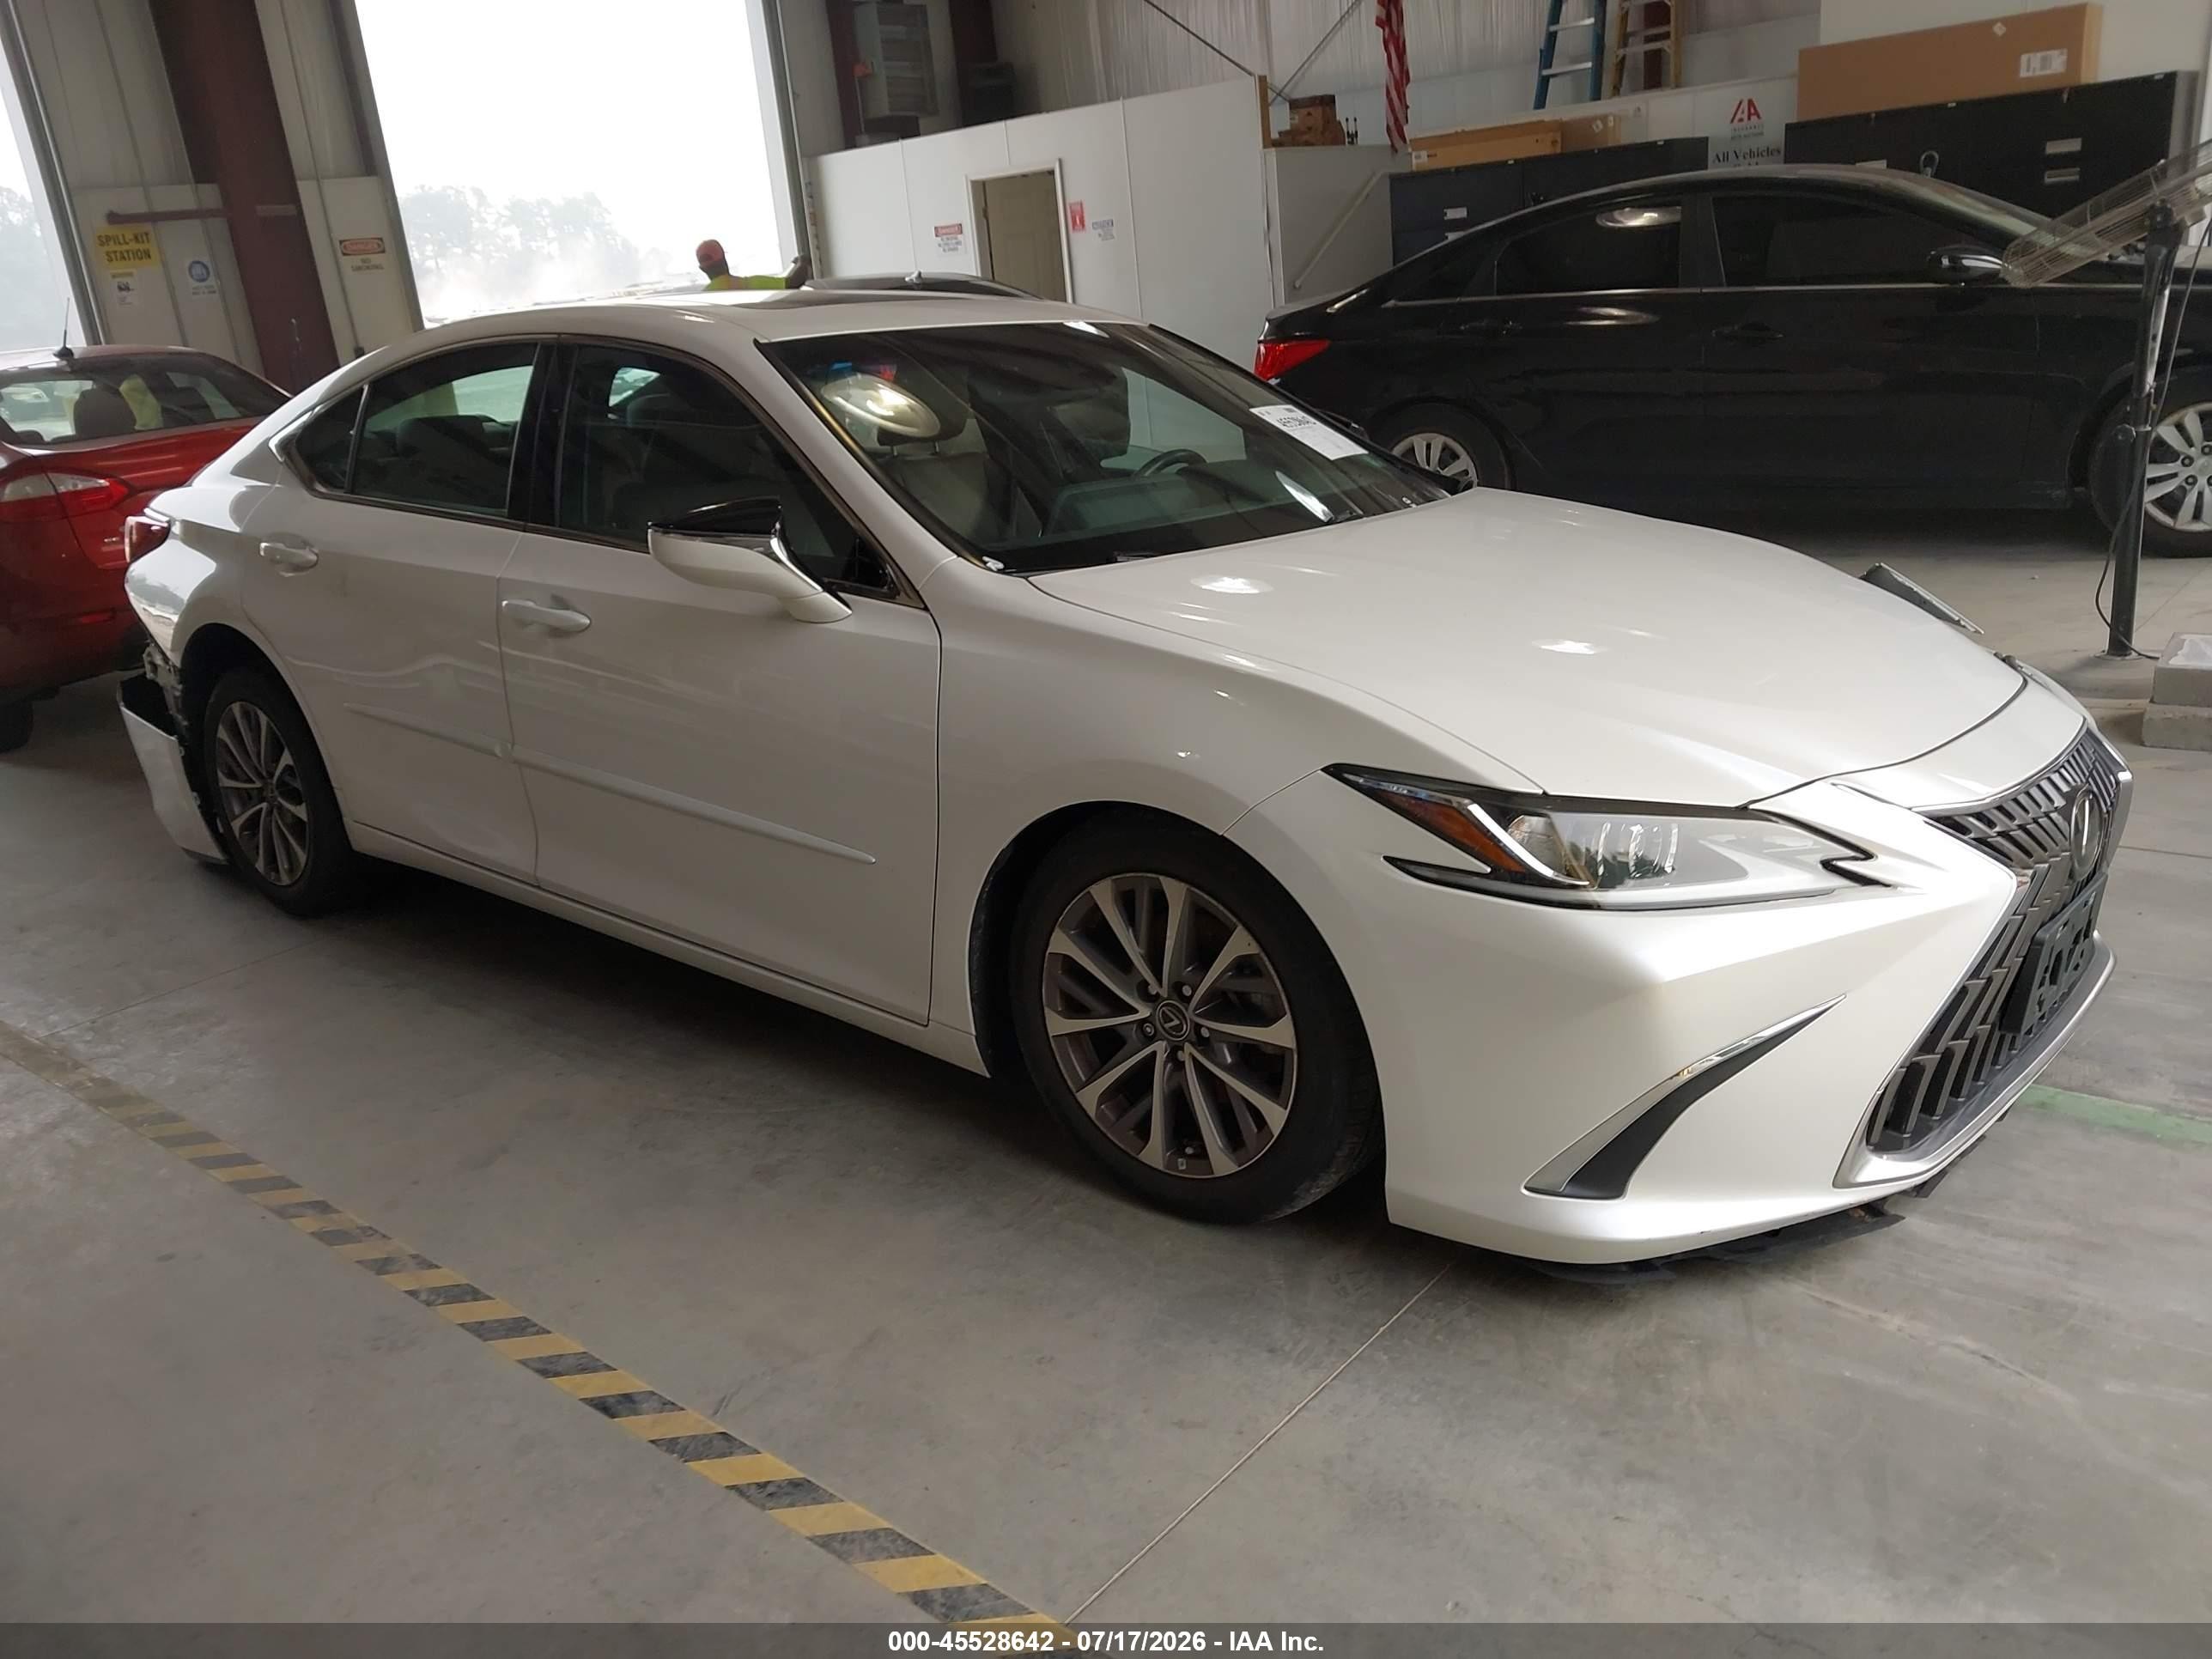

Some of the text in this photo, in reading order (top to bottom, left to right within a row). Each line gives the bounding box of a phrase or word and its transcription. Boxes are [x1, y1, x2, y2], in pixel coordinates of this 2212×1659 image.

[1713, 146, 1782, 163] All Vehicles
[97, 232, 151, 246] SPILL-KIT
[105, 248, 152, 263] STATION
